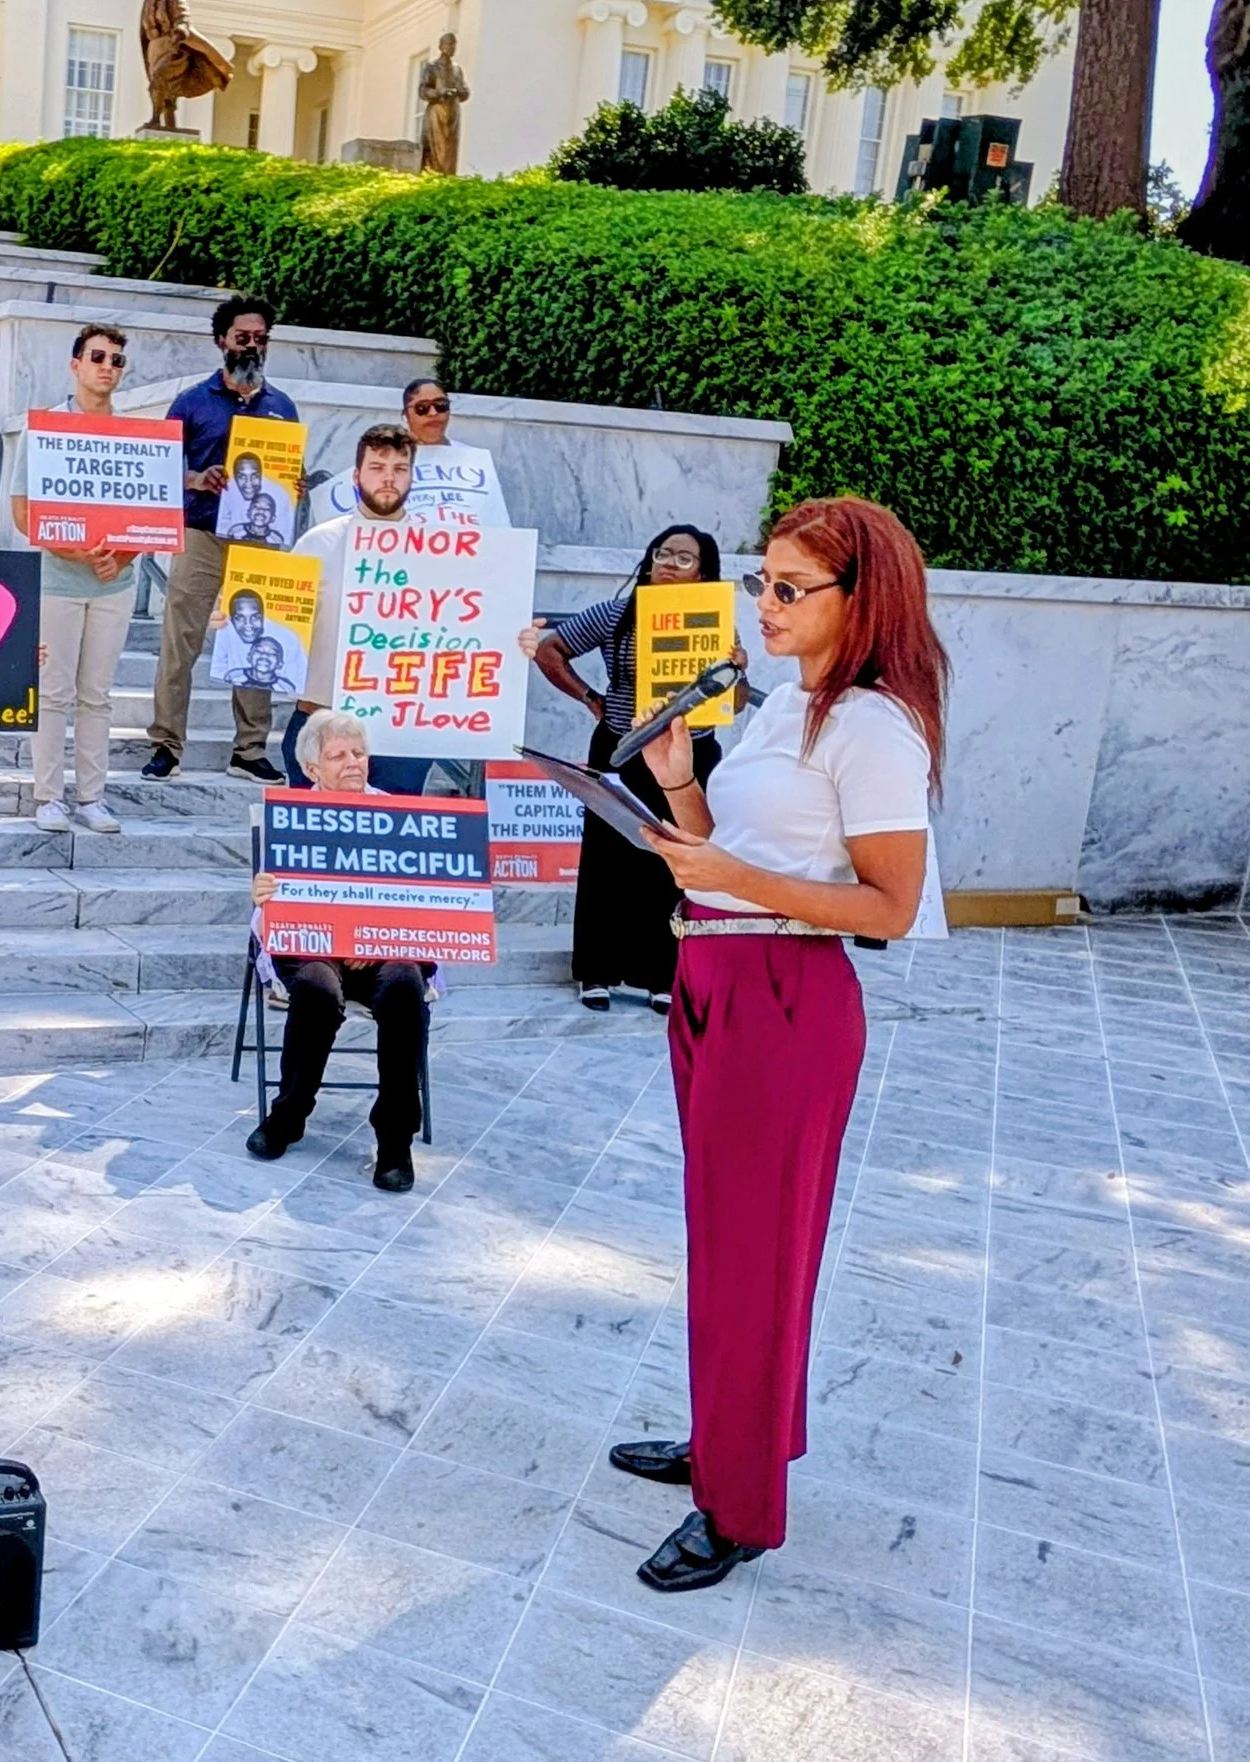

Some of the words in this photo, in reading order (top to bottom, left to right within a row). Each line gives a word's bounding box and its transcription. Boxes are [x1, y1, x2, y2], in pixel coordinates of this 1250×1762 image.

[37, 436, 63, 451] THE
[66, 438, 110, 454] DEATH
[114, 442, 171, 458] PENALTY
[65, 457, 145, 478] TARGETS
[41, 477, 95, 498] POOR
[101, 481, 169, 501] PEOPLE
[438, 505, 480, 526] THE
[37, 520, 86, 542] ACTION
[353, 526, 481, 556] HONOR
[354, 558, 409, 585] the
[346, 588, 483, 622] JURY'S
[651, 612, 681, 631] LIFE
[349, 623, 482, 650] Decision
[692, 634, 720, 652] FOR
[342, 650, 502, 698] LIFE
[340, 695, 382, 718] for
[498, 784, 546, 798] "THEM
[514, 804, 573, 818] CAPITAL
[272, 806, 394, 835] BLESSED
[399, 814, 457, 839] ARE
[491, 823, 519, 837] THE
[270, 844, 327, 869] THE
[334, 847, 483, 878] MERCIFUL
[493, 859, 538, 878] ACTION
[308, 884, 338, 903] they
[342, 886, 374, 901] shall
[378, 889, 425, 903] receive
[430, 892, 480, 908] mercy."
[266, 929, 332, 955] ACTION
[353, 926, 490, 946] #STOPEXECUTIONS
[354, 944, 490, 962] DEATHPENALTY.ORG
